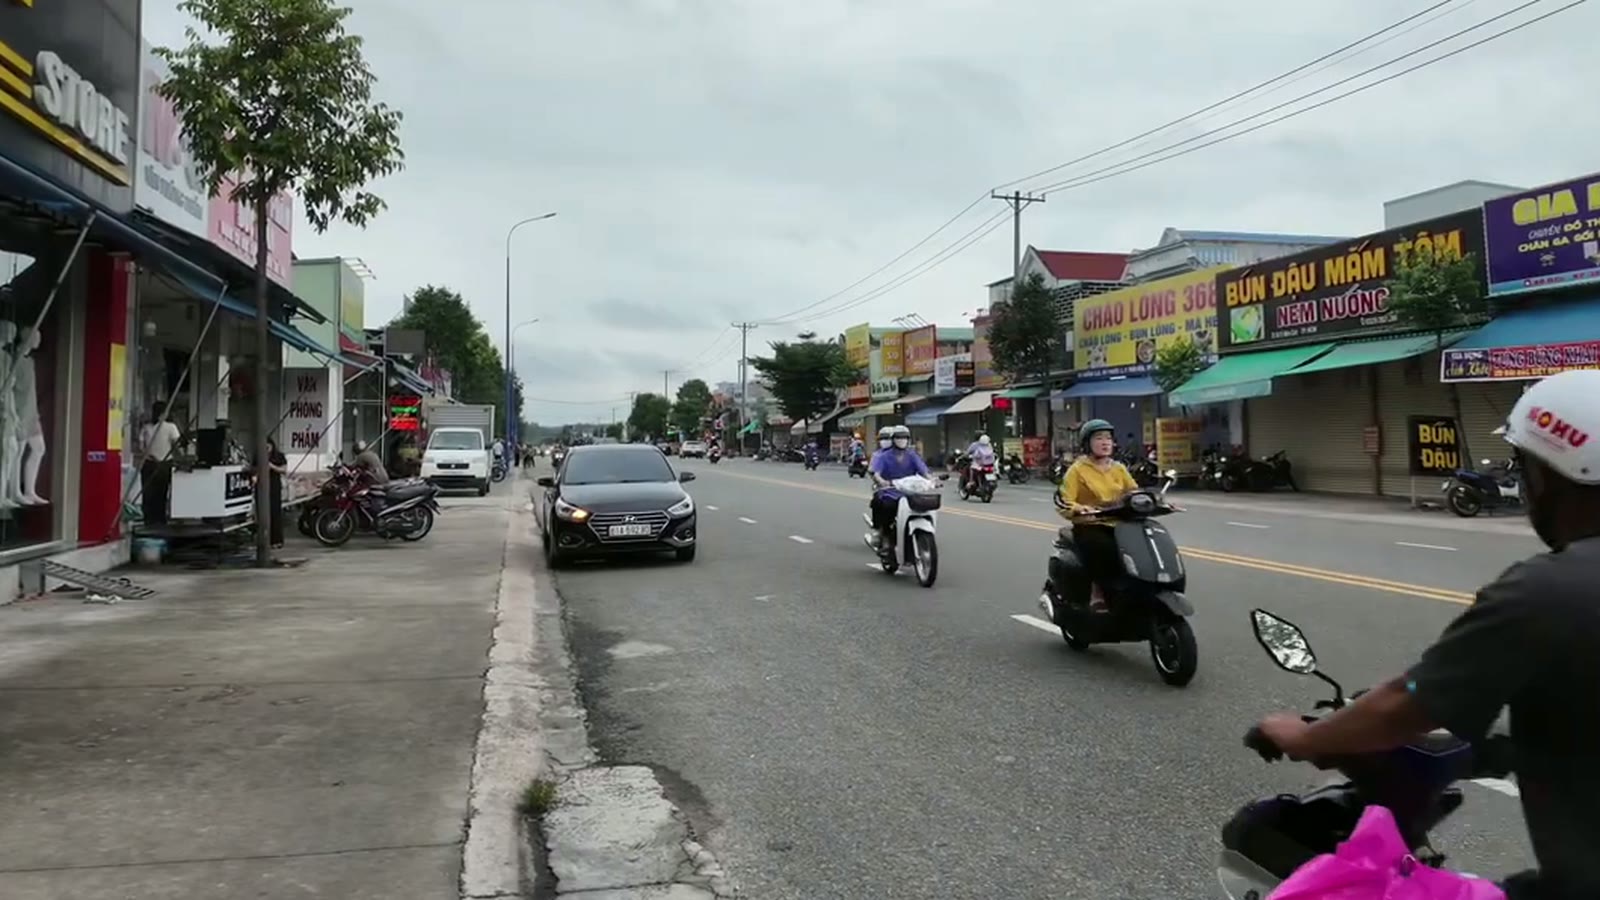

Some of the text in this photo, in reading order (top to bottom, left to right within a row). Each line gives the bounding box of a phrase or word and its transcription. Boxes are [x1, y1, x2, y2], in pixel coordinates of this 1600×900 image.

[34, 51, 130, 166] STORE
[1513, 189, 1578, 226] GIA
[1553, 237, 1570, 248] GA
[1226, 270, 1266, 307] BÚN
[1271, 262, 1316, 300] ĐẬU
[1324, 240, 1386, 286] MẮM
[1183, 281, 1217, 313] 368
[1276, 301, 1317, 328] NEM
[1418, 421, 1455, 443] BÚN
